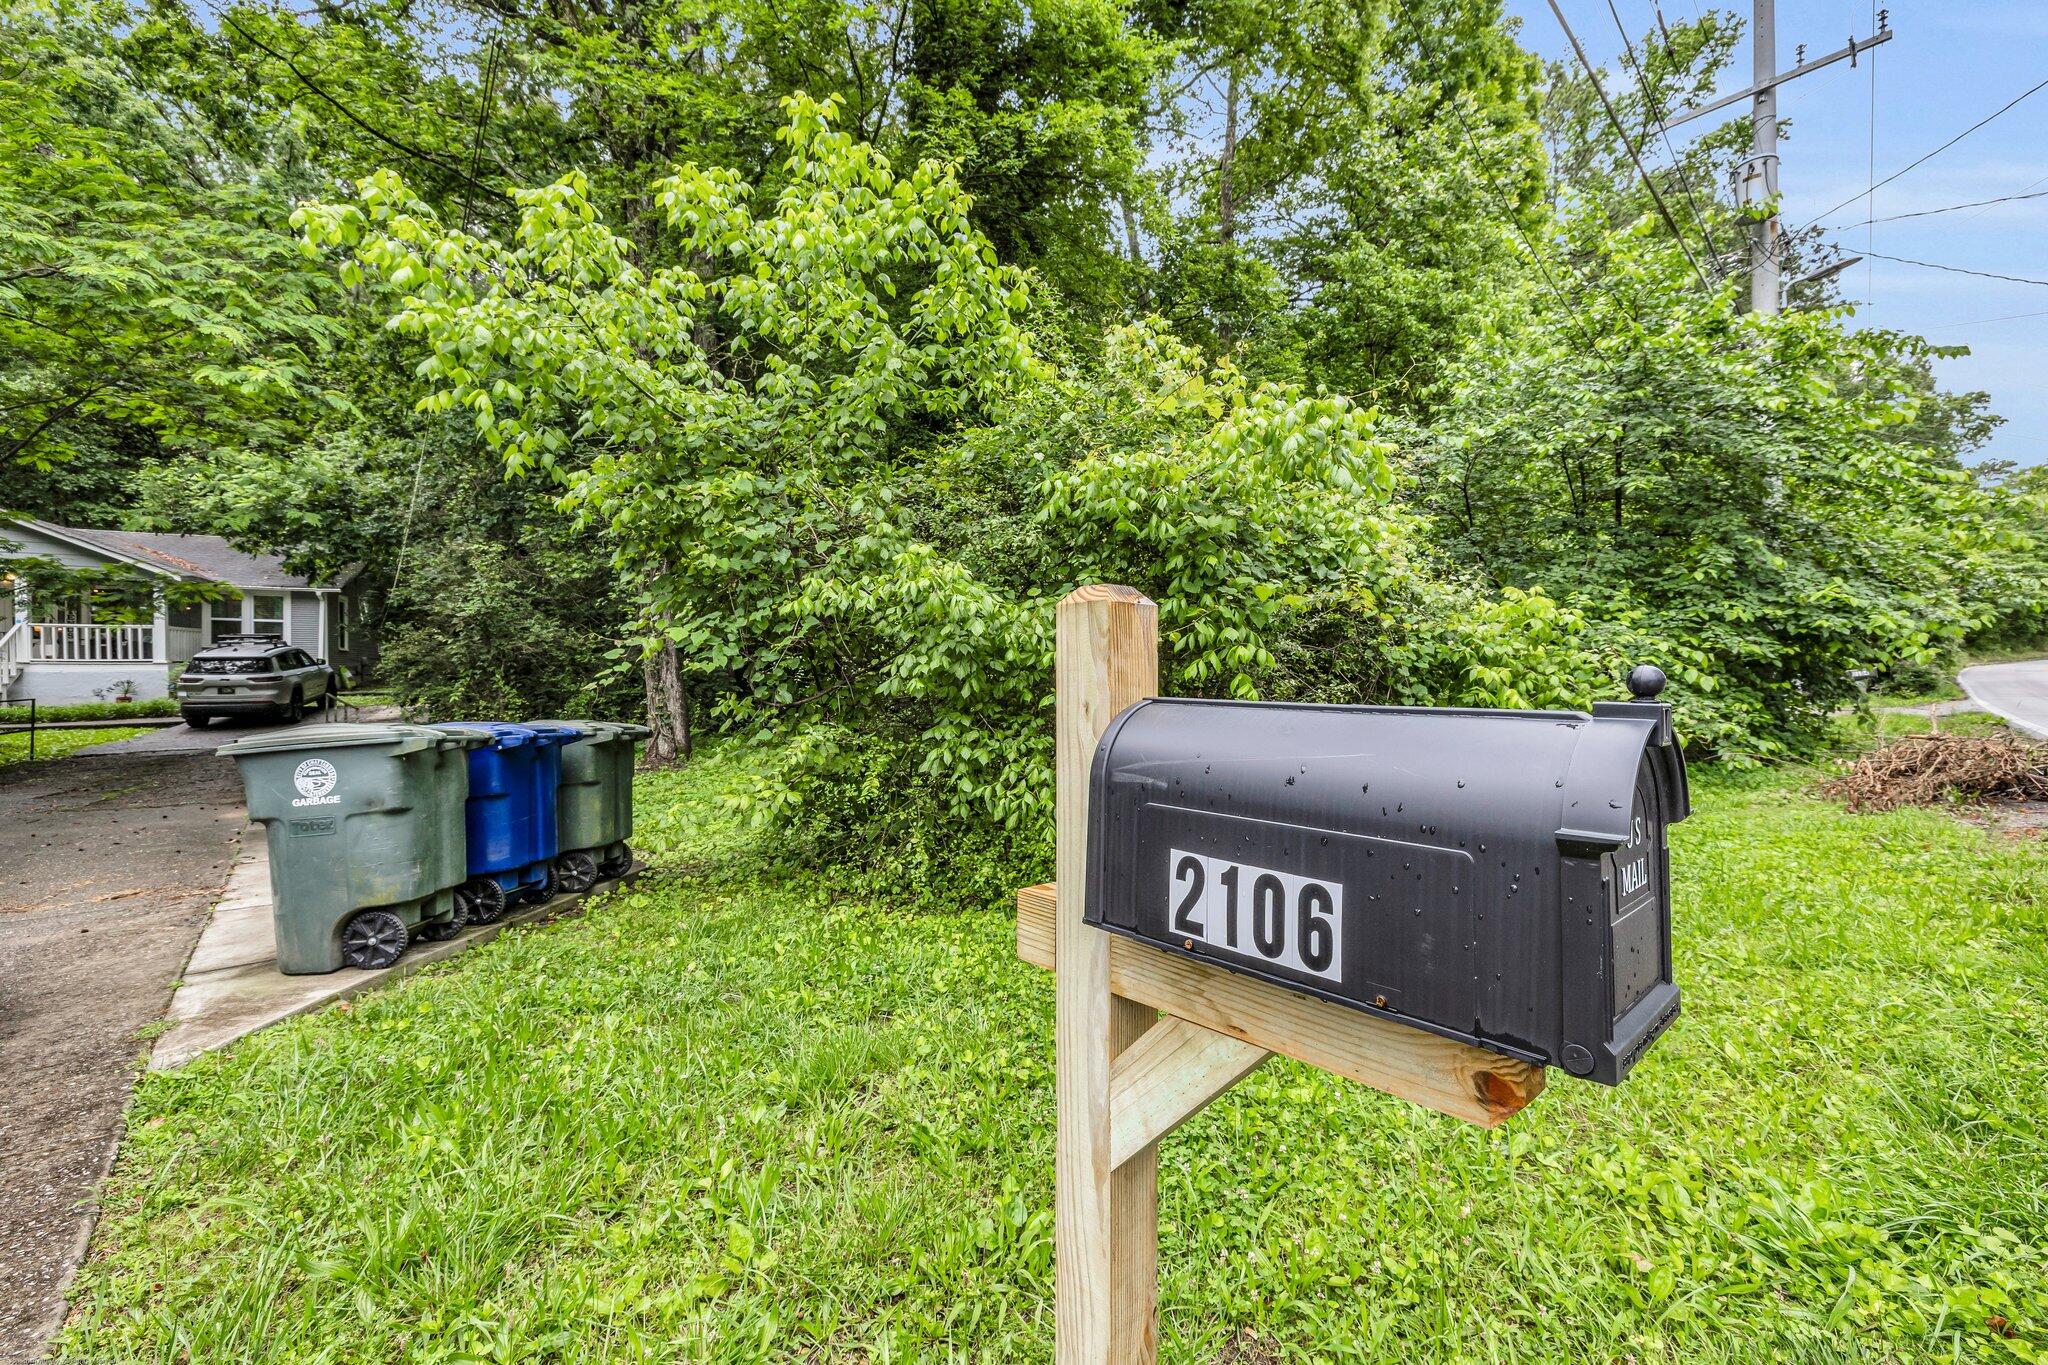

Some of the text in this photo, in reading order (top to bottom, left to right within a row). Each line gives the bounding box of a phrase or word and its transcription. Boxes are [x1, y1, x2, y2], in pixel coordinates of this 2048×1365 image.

[292, 795, 341, 807] GARBAGE
[1621, 858, 1648, 897] MAIL
[1174, 855, 1334, 973] 2106
